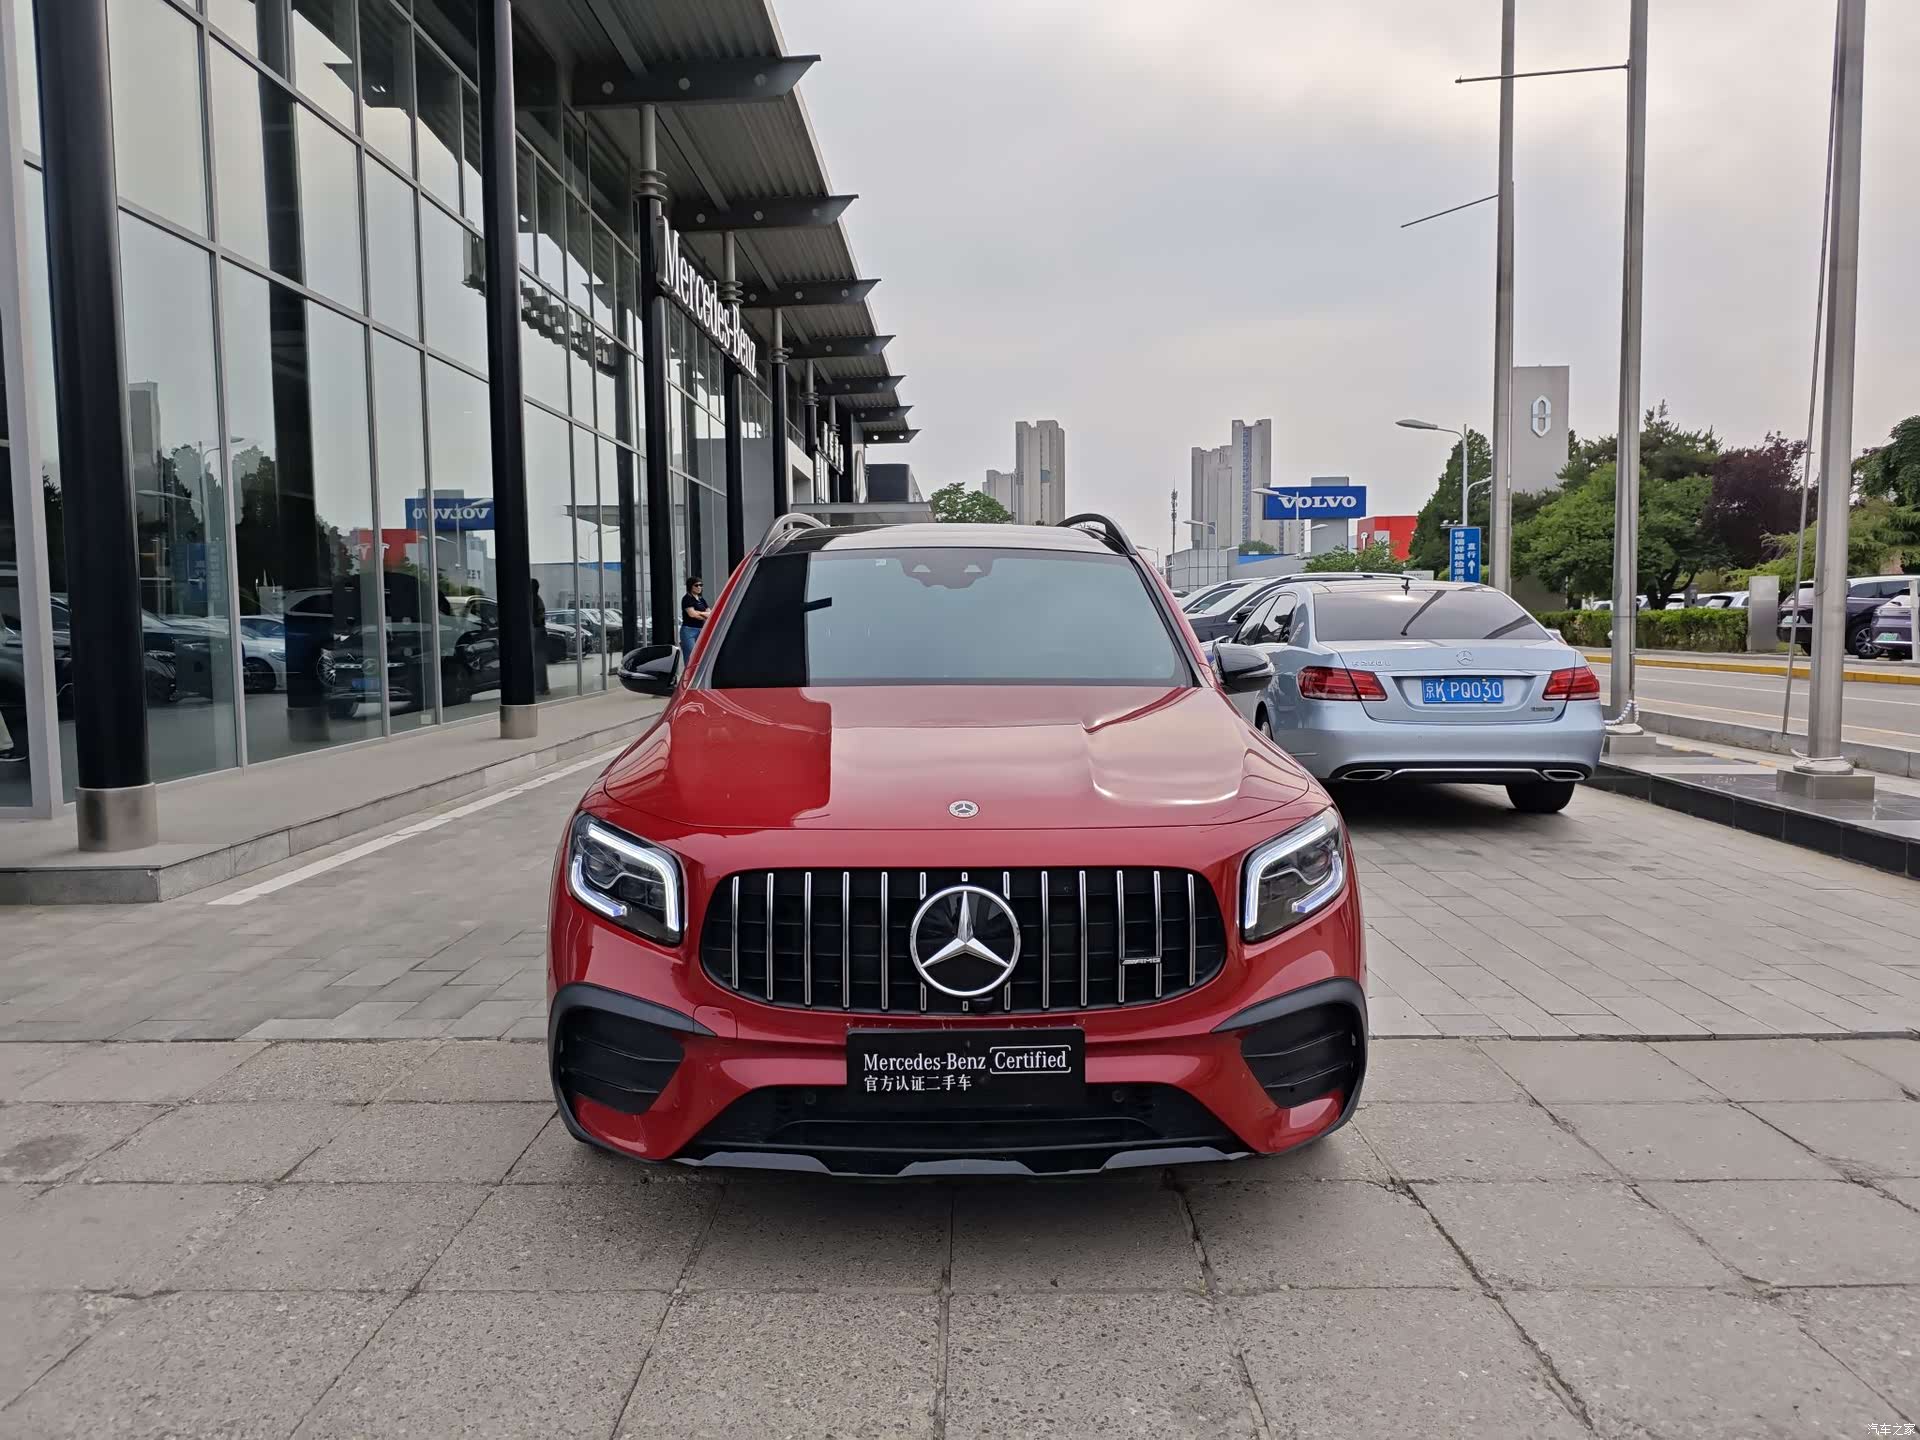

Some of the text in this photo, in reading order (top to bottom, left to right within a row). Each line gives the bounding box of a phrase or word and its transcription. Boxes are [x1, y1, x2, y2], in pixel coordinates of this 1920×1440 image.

[663, 215, 757, 378] Mercedes-Benz
[1278, 495, 1357, 509] VOLVO
[863, 1050, 1067, 1072] Mercedes-Benz Certified
[863, 1074, 973, 1092] 官方认证二手车
